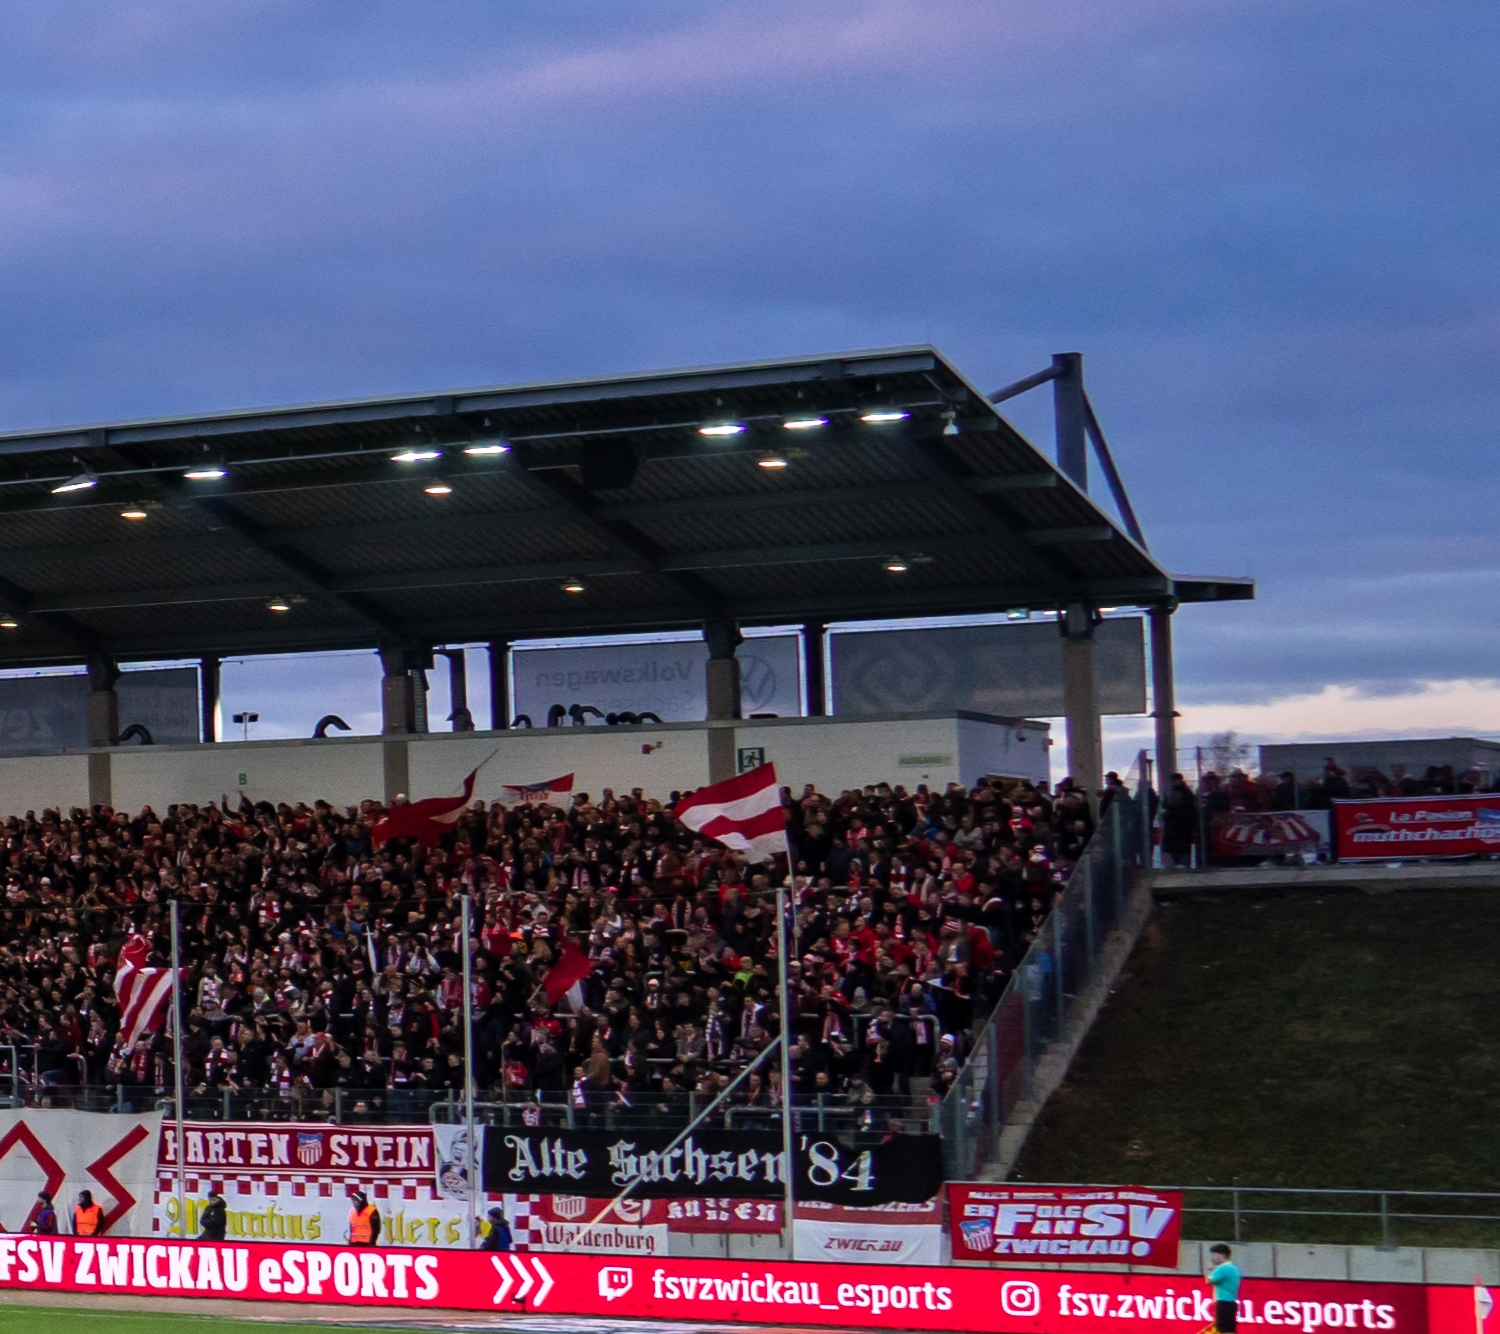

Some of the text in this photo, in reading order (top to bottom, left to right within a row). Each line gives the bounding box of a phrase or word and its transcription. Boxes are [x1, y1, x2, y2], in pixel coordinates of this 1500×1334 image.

[164, 1129, 290, 1166] HARTEN
[329, 1134, 430, 1168] STEIN
[503, 1133, 589, 1182] Alte
[606, 1135, 787, 1187] Sachsen
[823, 1237, 904, 1253] ZWICKAU
[73, 1241, 250, 1292] ZWICKAU
[258, 1249, 440, 1300] eSPORTS
[651, 1268, 954, 1315] fsvzwickau_esports
[1056, 1284, 1396, 1333] fsv.zwicku.esports
